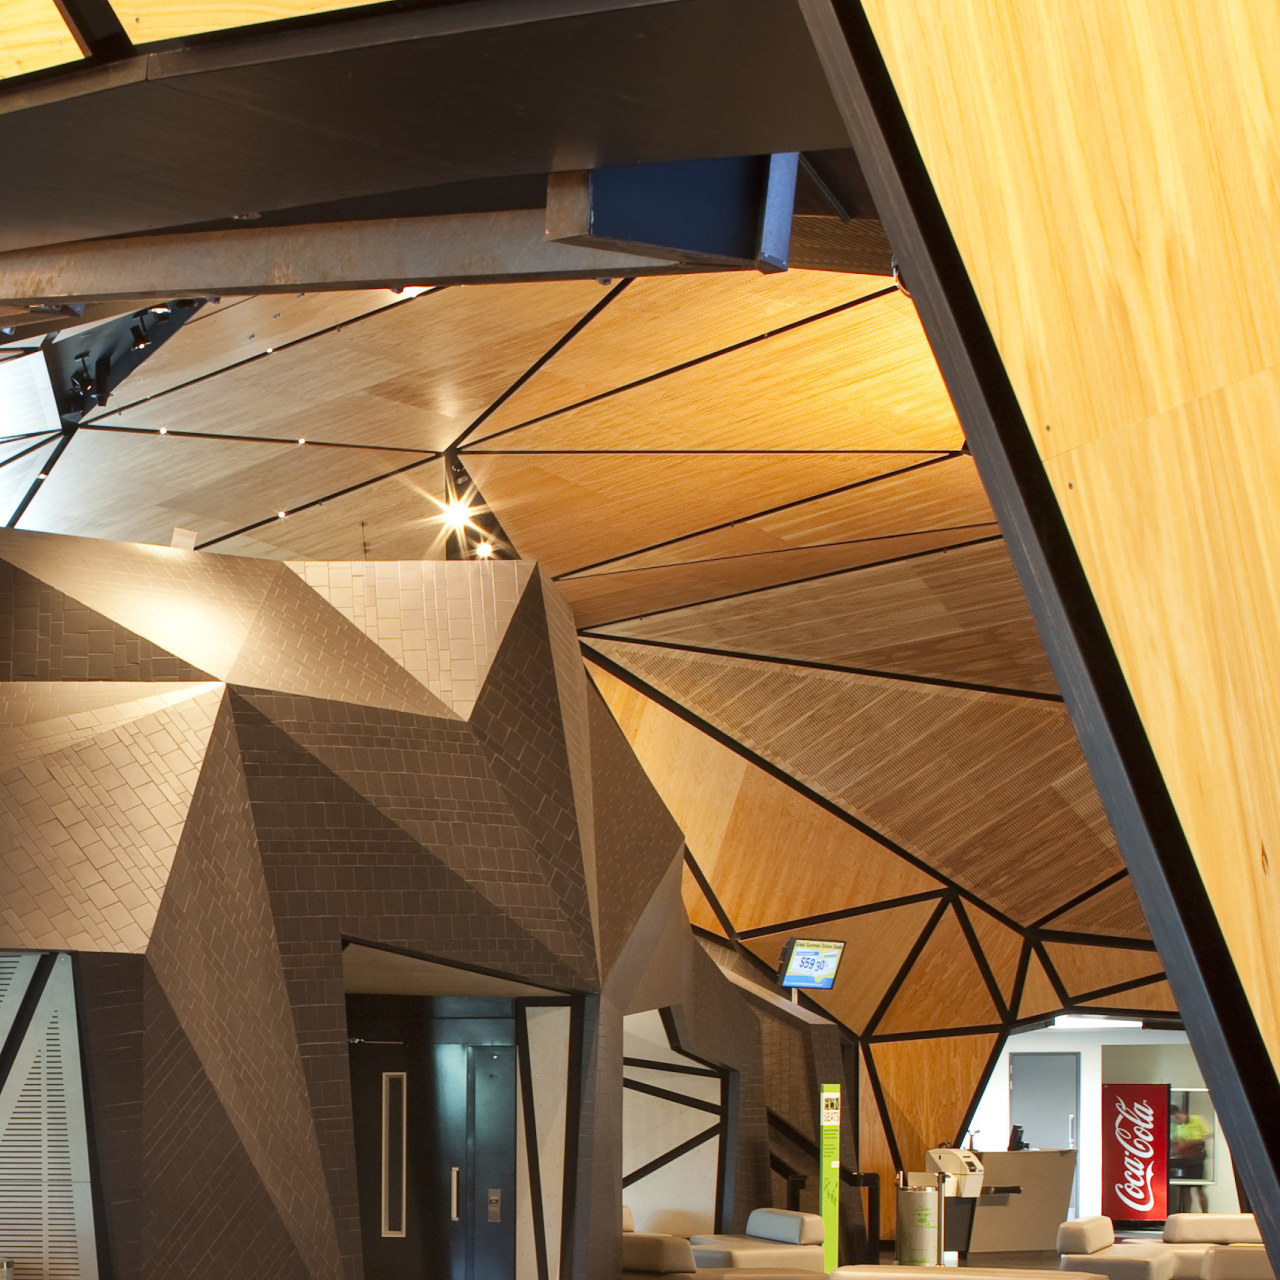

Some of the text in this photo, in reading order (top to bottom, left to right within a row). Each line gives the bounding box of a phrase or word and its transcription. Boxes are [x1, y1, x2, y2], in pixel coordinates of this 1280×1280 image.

[799, 956, 815, 969] $59
[815, 960, 825, 972] 30
[1115, 1095, 1154, 1212] Coca-Cola
